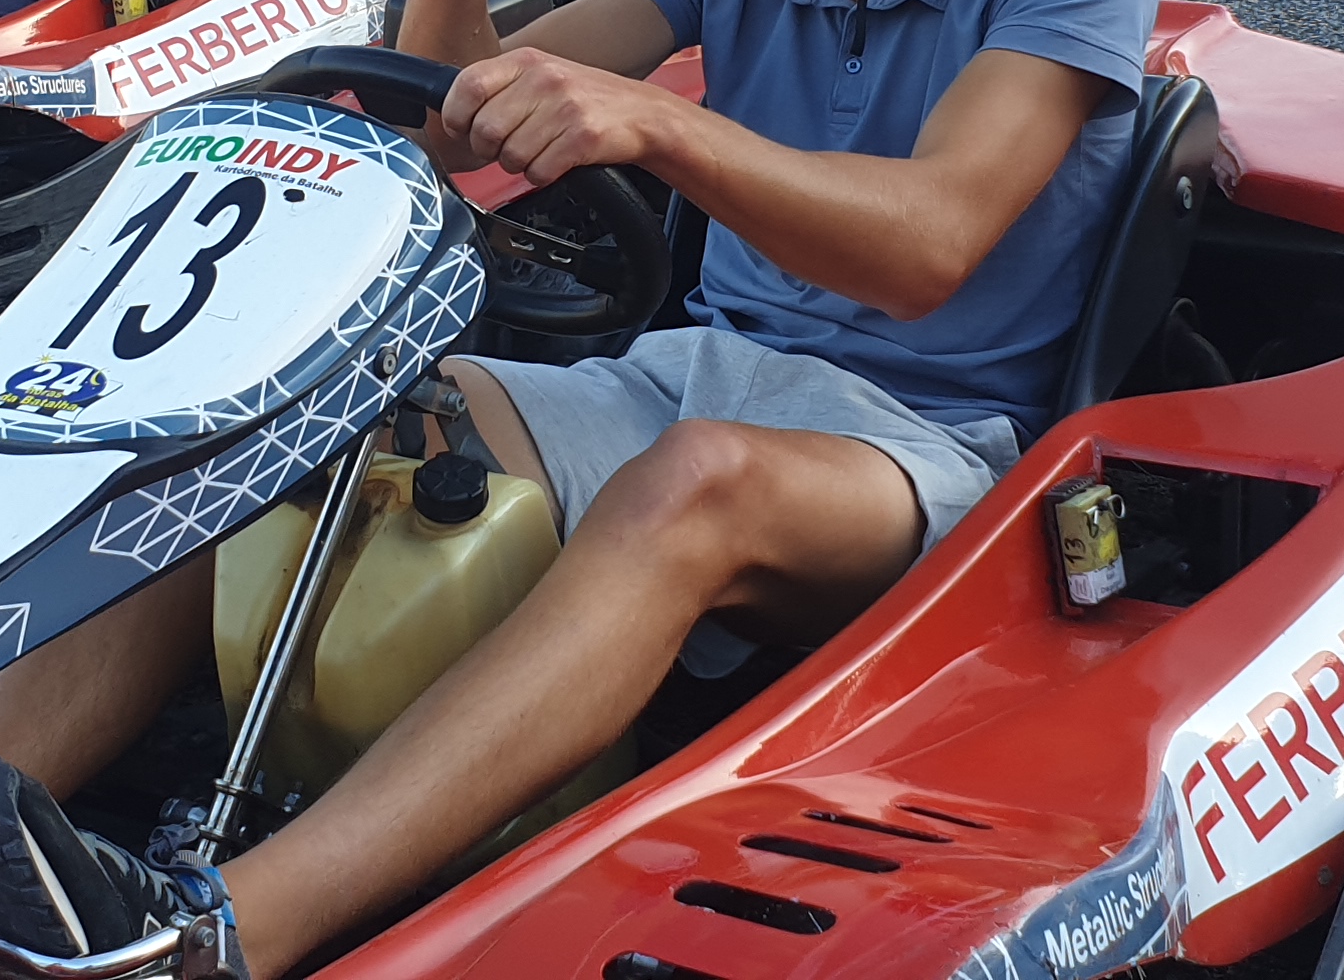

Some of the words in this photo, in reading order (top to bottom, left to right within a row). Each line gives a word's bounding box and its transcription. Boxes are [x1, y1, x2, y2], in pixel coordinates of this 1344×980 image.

[31, 74, 86, 95] Structures
[134, 135, 361, 181] EUROINDY
[280, 174, 296, 184] da
[297, 178, 344, 198] Batalha
[48, 172, 267, 360] 13
[15, 363, 94, 396] 24
[25, 385, 65, 398] horas
[0, 393, 18, 403] da
[20, 396, 79, 412] Batalha
[1043, 888, 1134, 969] Metallic
